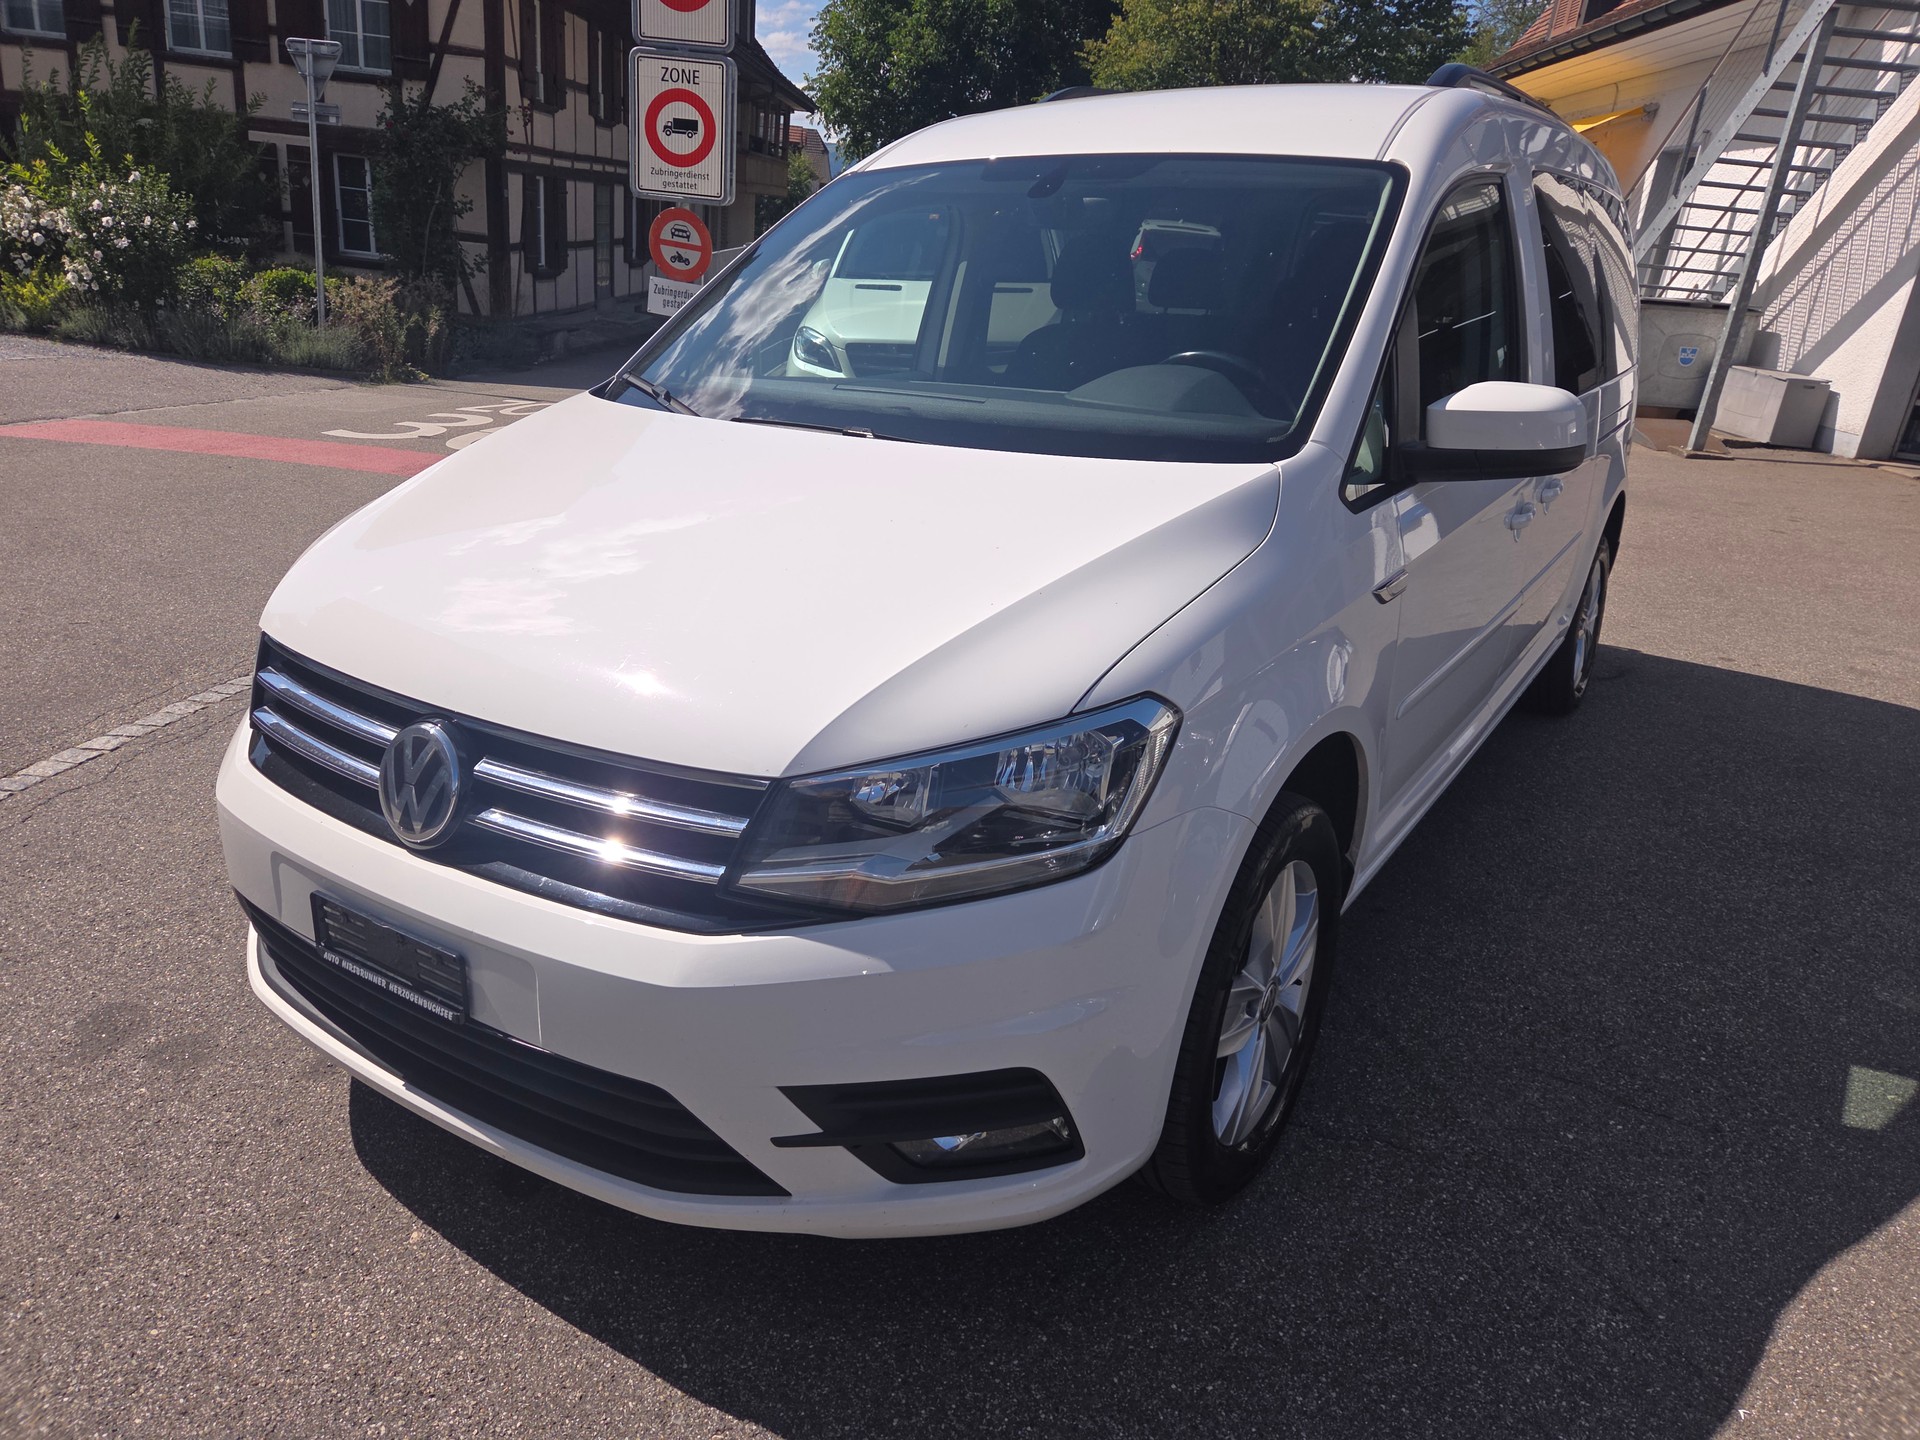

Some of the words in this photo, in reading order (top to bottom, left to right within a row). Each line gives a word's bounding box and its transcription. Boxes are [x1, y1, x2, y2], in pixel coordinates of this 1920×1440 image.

[660, 66, 700, 85] ZONE
[650, 166, 710, 181] Zubringerdienst
[662, 180, 698, 190] gestattet
[653, 283, 695, 299] Zubringerdie
[323, 951, 339, 965] AUTO
[341, 958, 387, 989] HIRSBRUNNER
[388, 982, 453, 1021] HERZOGENBUCHSEE
